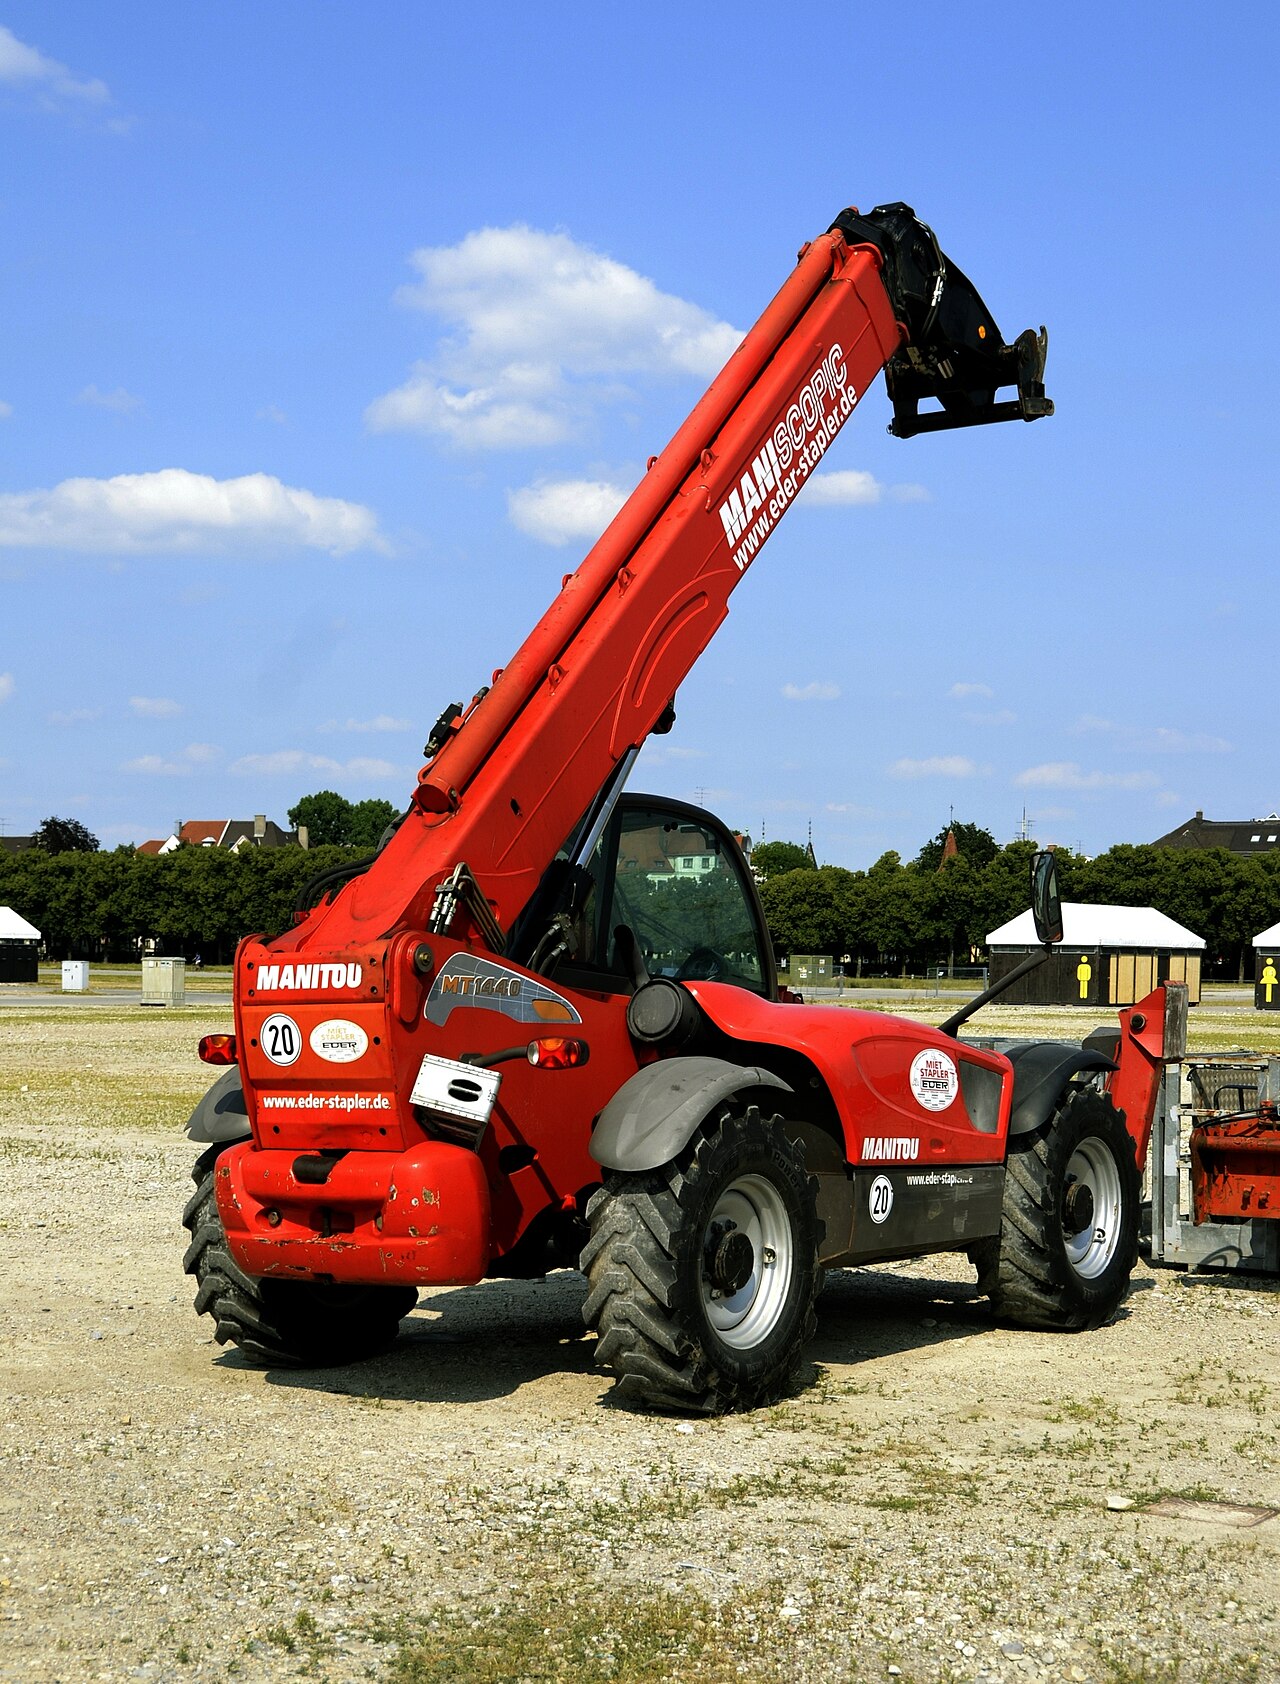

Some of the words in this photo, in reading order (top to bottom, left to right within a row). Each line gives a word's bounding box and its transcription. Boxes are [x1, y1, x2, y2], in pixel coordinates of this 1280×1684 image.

[718, 343, 848, 549] MANISCOPIC
[732, 385, 858, 572] www.eder-stapler.de
[256, 963, 362, 990] MANITOU
[441, 975, 521, 996] MT1440
[268, 1024, 295, 1056] 20
[920, 1068, 949, 1078] STAPLER
[925, 1060, 942, 1069] MIET
[922, 1080, 948, 1089] EDER
[263, 1094, 389, 1112] www.eder-stapler.de
[862, 1137, 919, 1160] MANITOU
[873, 1185, 888, 1215] 20
